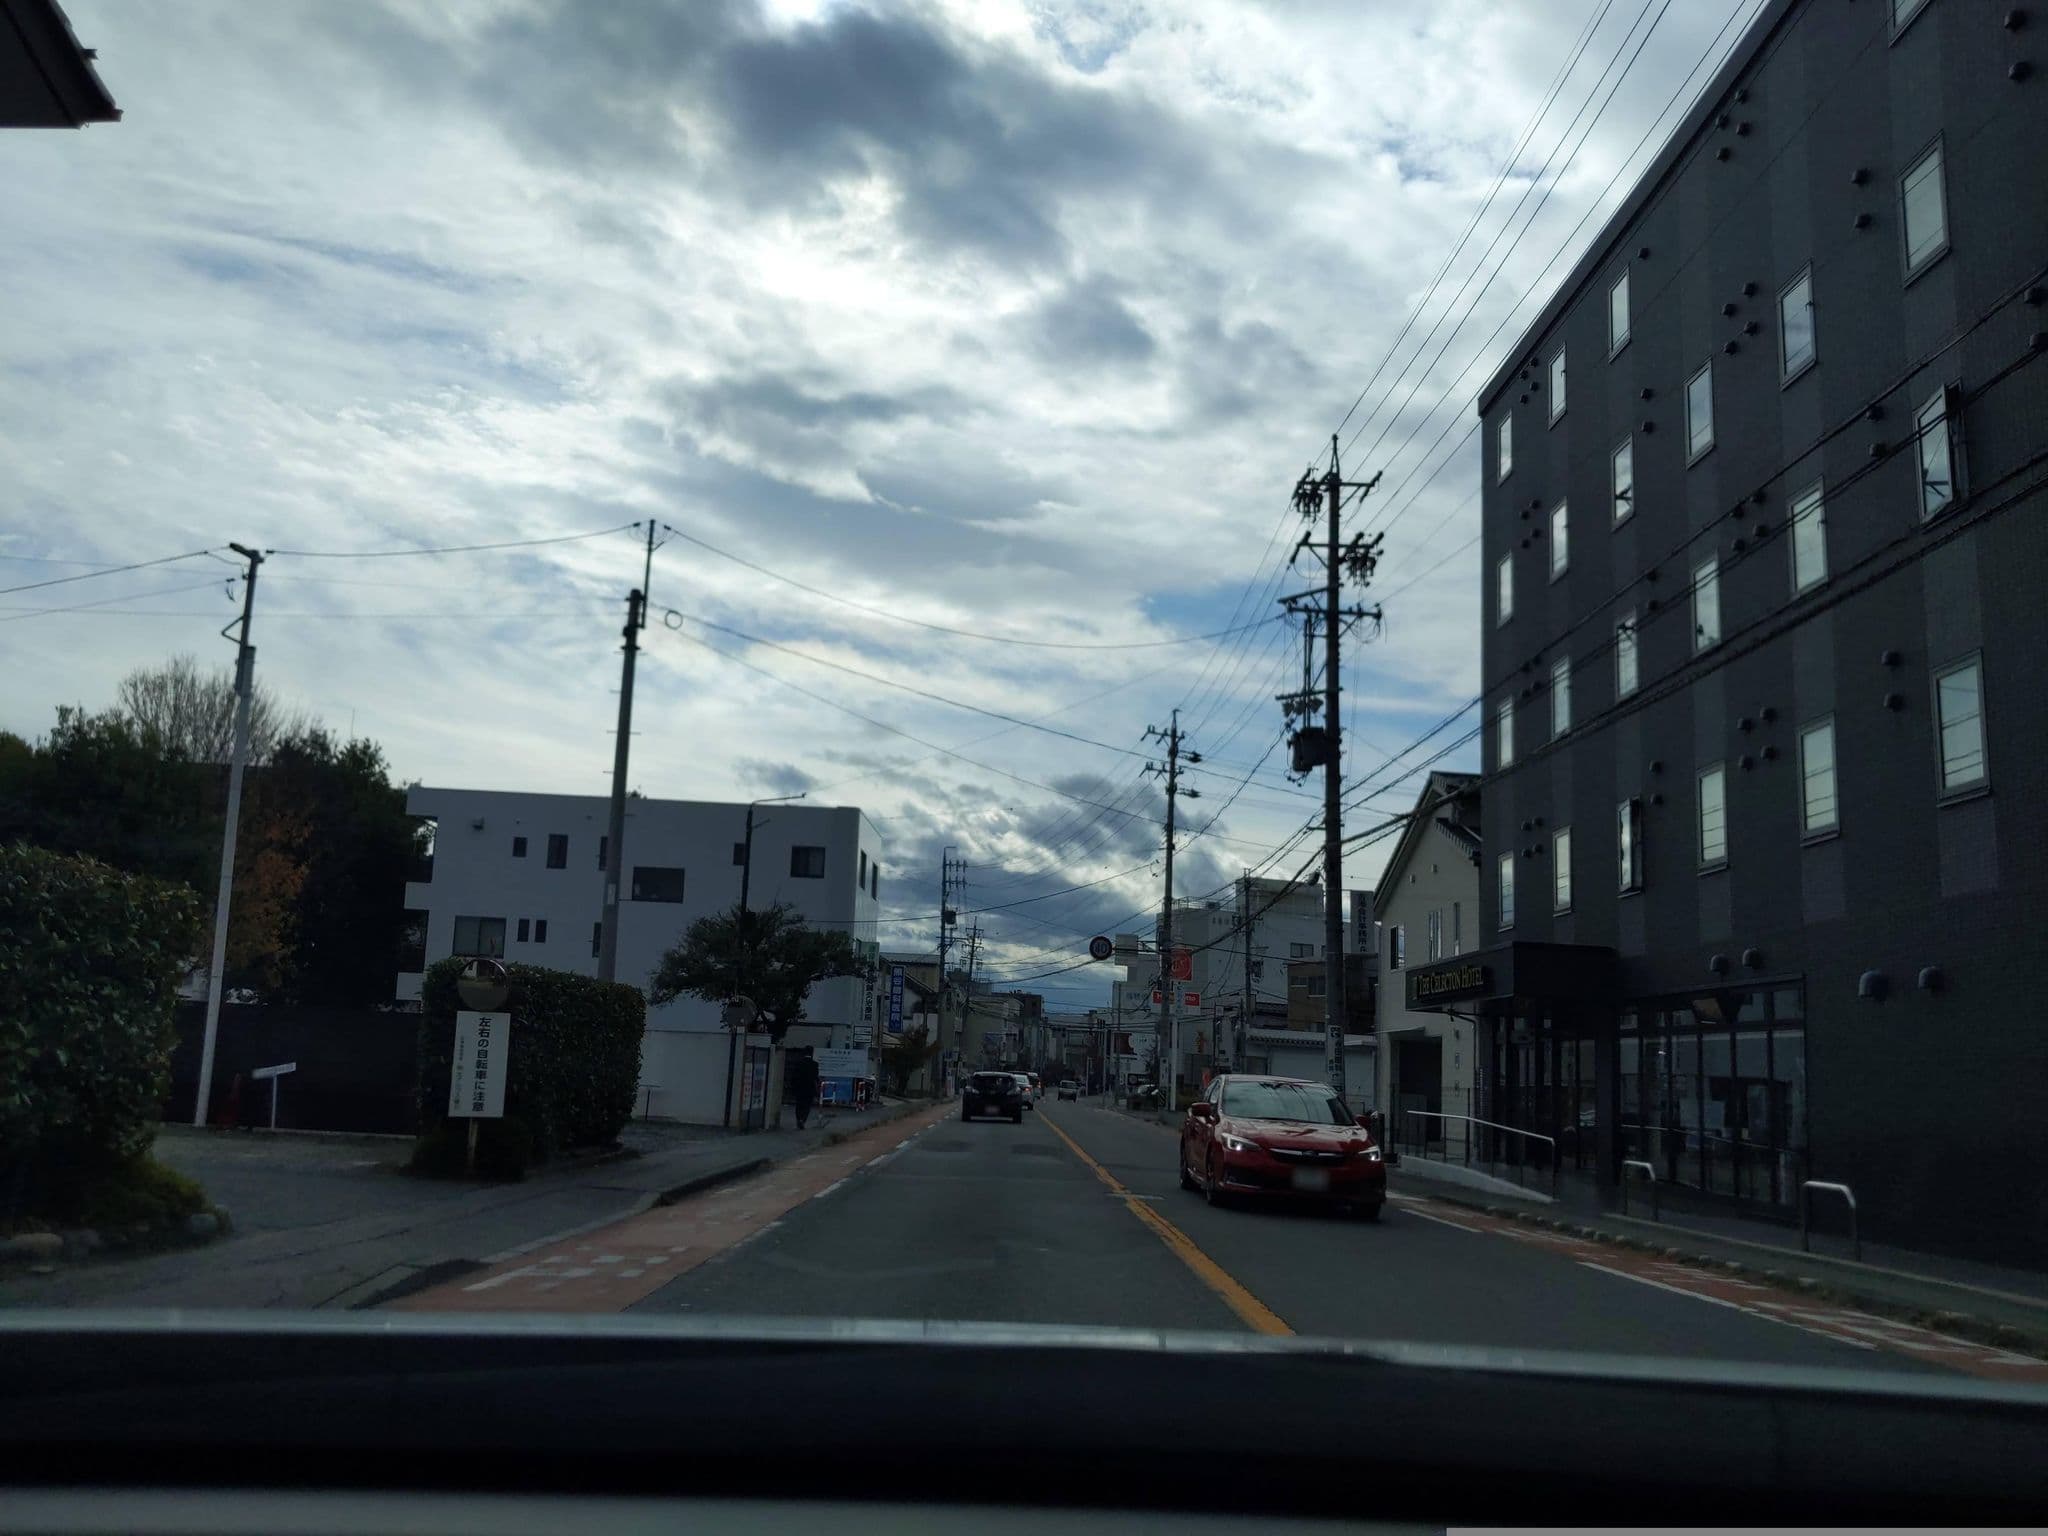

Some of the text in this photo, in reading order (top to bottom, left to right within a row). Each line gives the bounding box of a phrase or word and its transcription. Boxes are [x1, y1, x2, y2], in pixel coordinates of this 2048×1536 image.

[472, 1017, 492, 1112] 左右の自転車に注意
